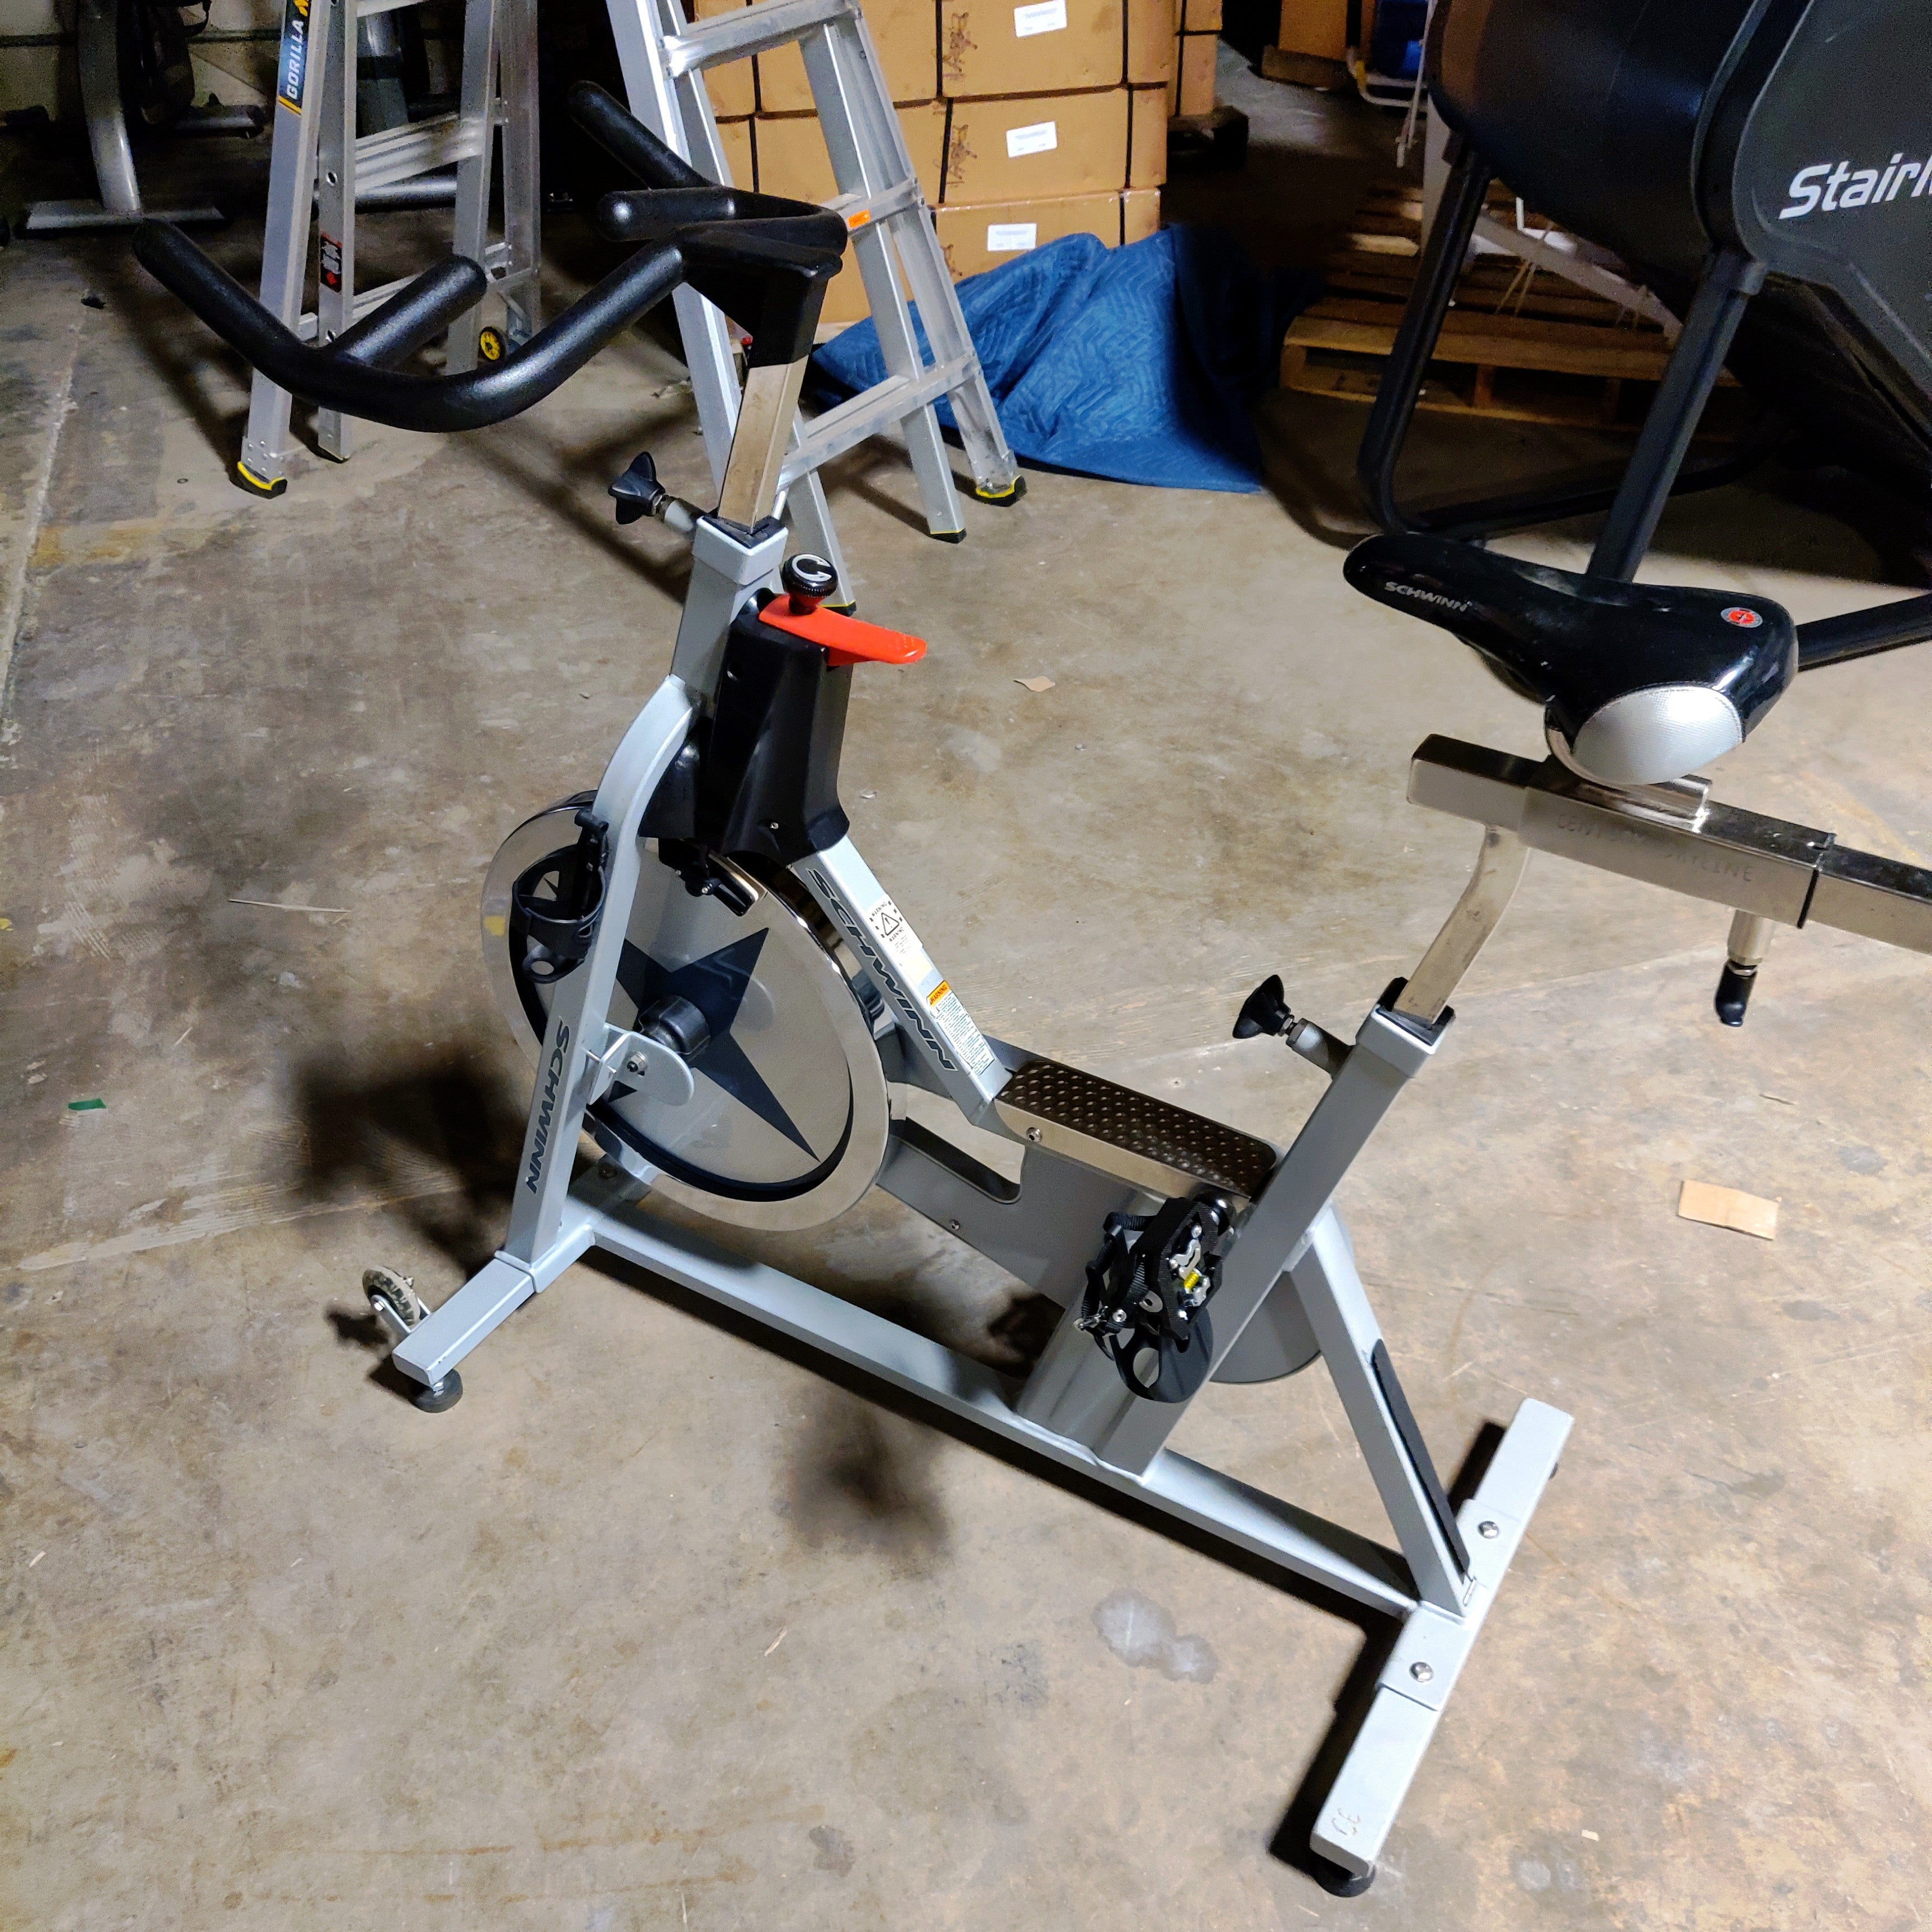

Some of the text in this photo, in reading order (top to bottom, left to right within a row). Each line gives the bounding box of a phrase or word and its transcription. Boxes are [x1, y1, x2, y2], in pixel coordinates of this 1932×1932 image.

[287, 20, 304, 100] GORILLA
[1385, 581, 1472, 612] SCHWINN
[872, 901, 887, 917] WARNING
[889, 926, 905, 942] WARNING
[806, 868, 958, 1072] SCHWINN
[930, 984, 948, 1003] WARNING
[525, 1019, 569, 1194] SCHWINN
